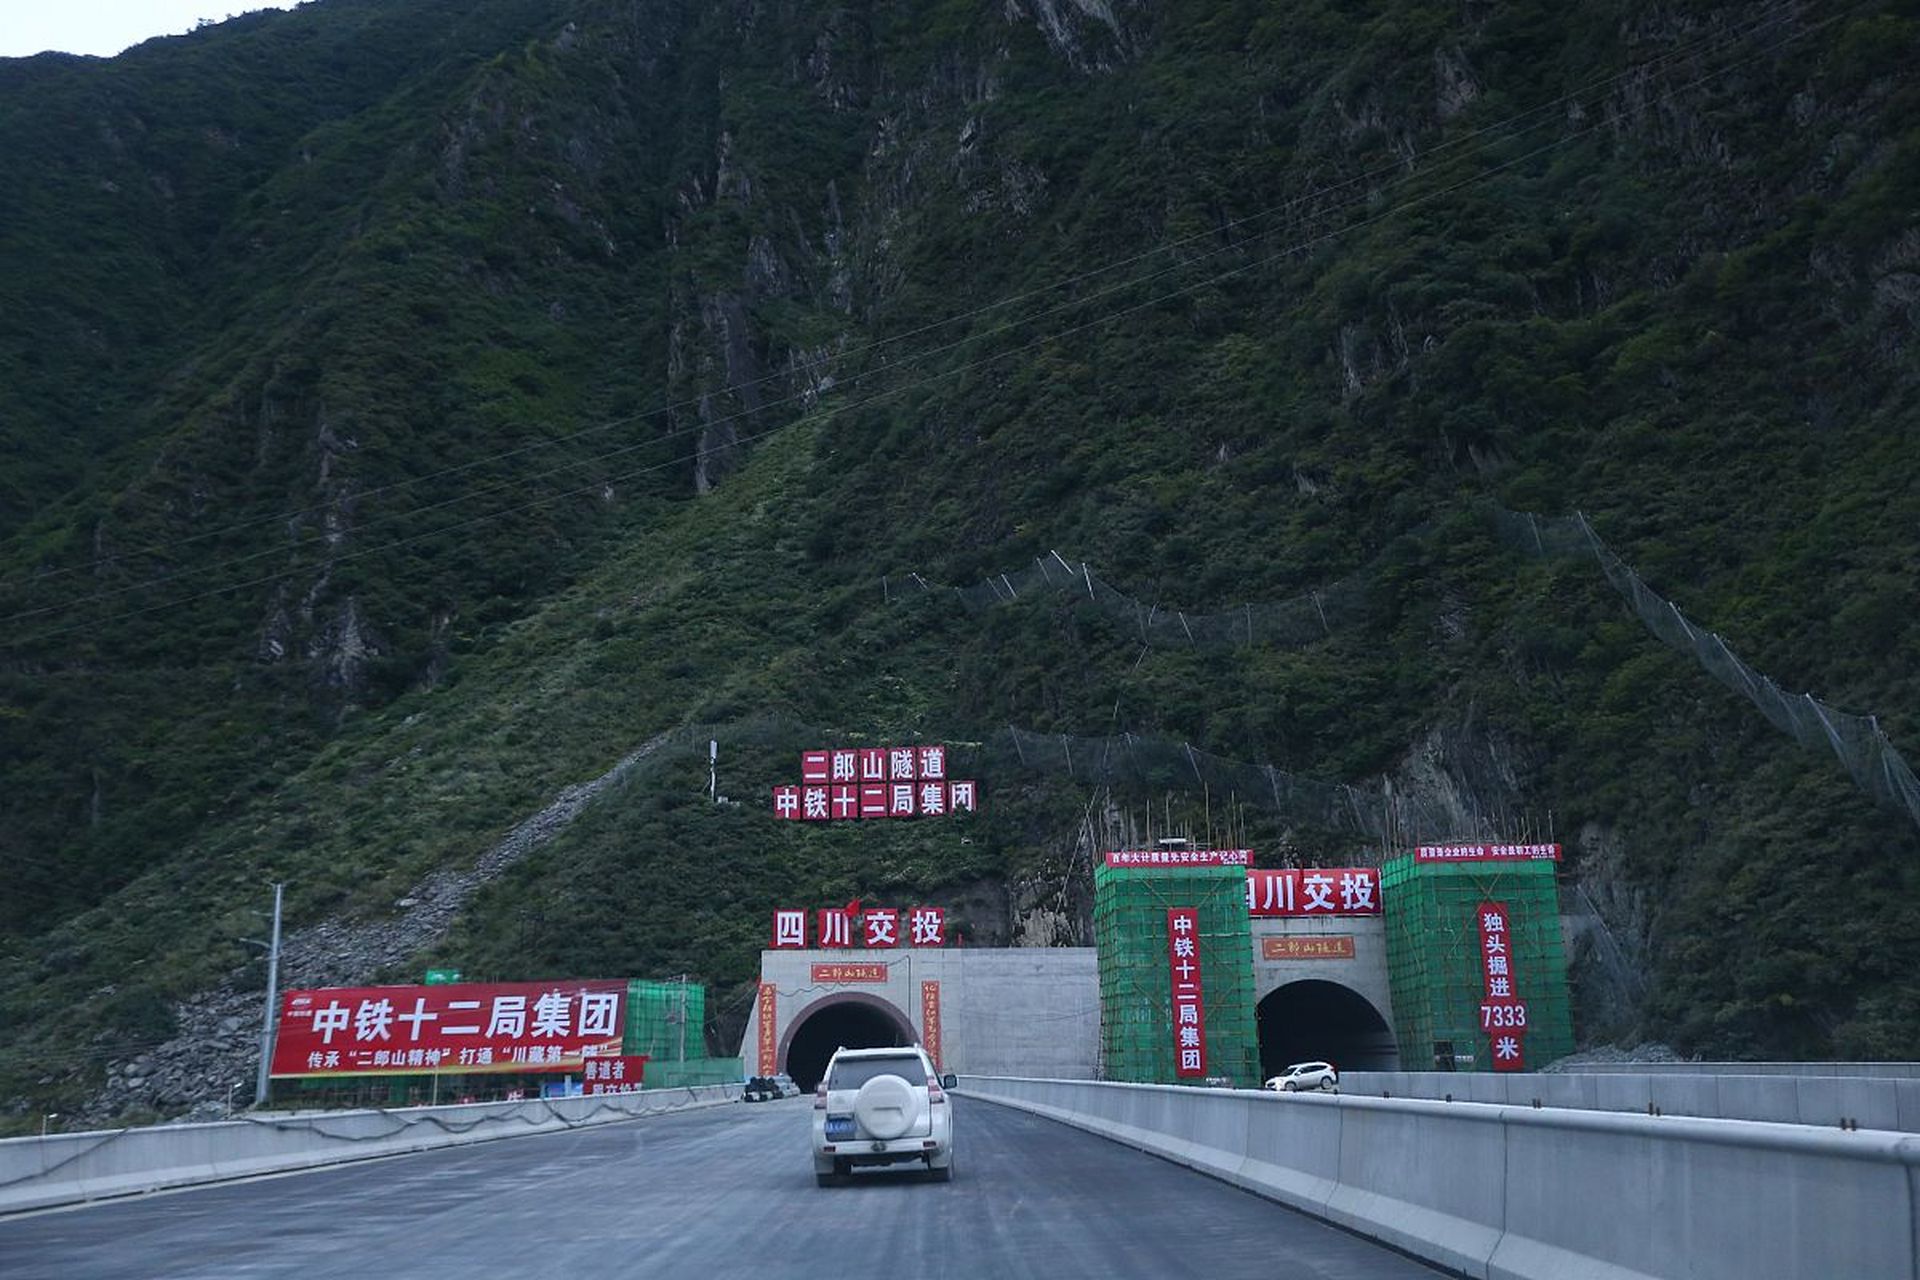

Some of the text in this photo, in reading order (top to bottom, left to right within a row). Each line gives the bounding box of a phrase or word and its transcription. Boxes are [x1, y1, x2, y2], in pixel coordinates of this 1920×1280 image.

[804, 748, 944, 783] 二郎山隧道
[776, 783, 974, 819] 中铁十二局集团
[776, 910, 942, 947] 四川交投
[1173, 914, 1201, 1070] 中铁十二局集团
[1481, 912, 1526, 1060] 独头掘进 7333 米
[311, 992, 619, 1045] 中铁十二局集团
